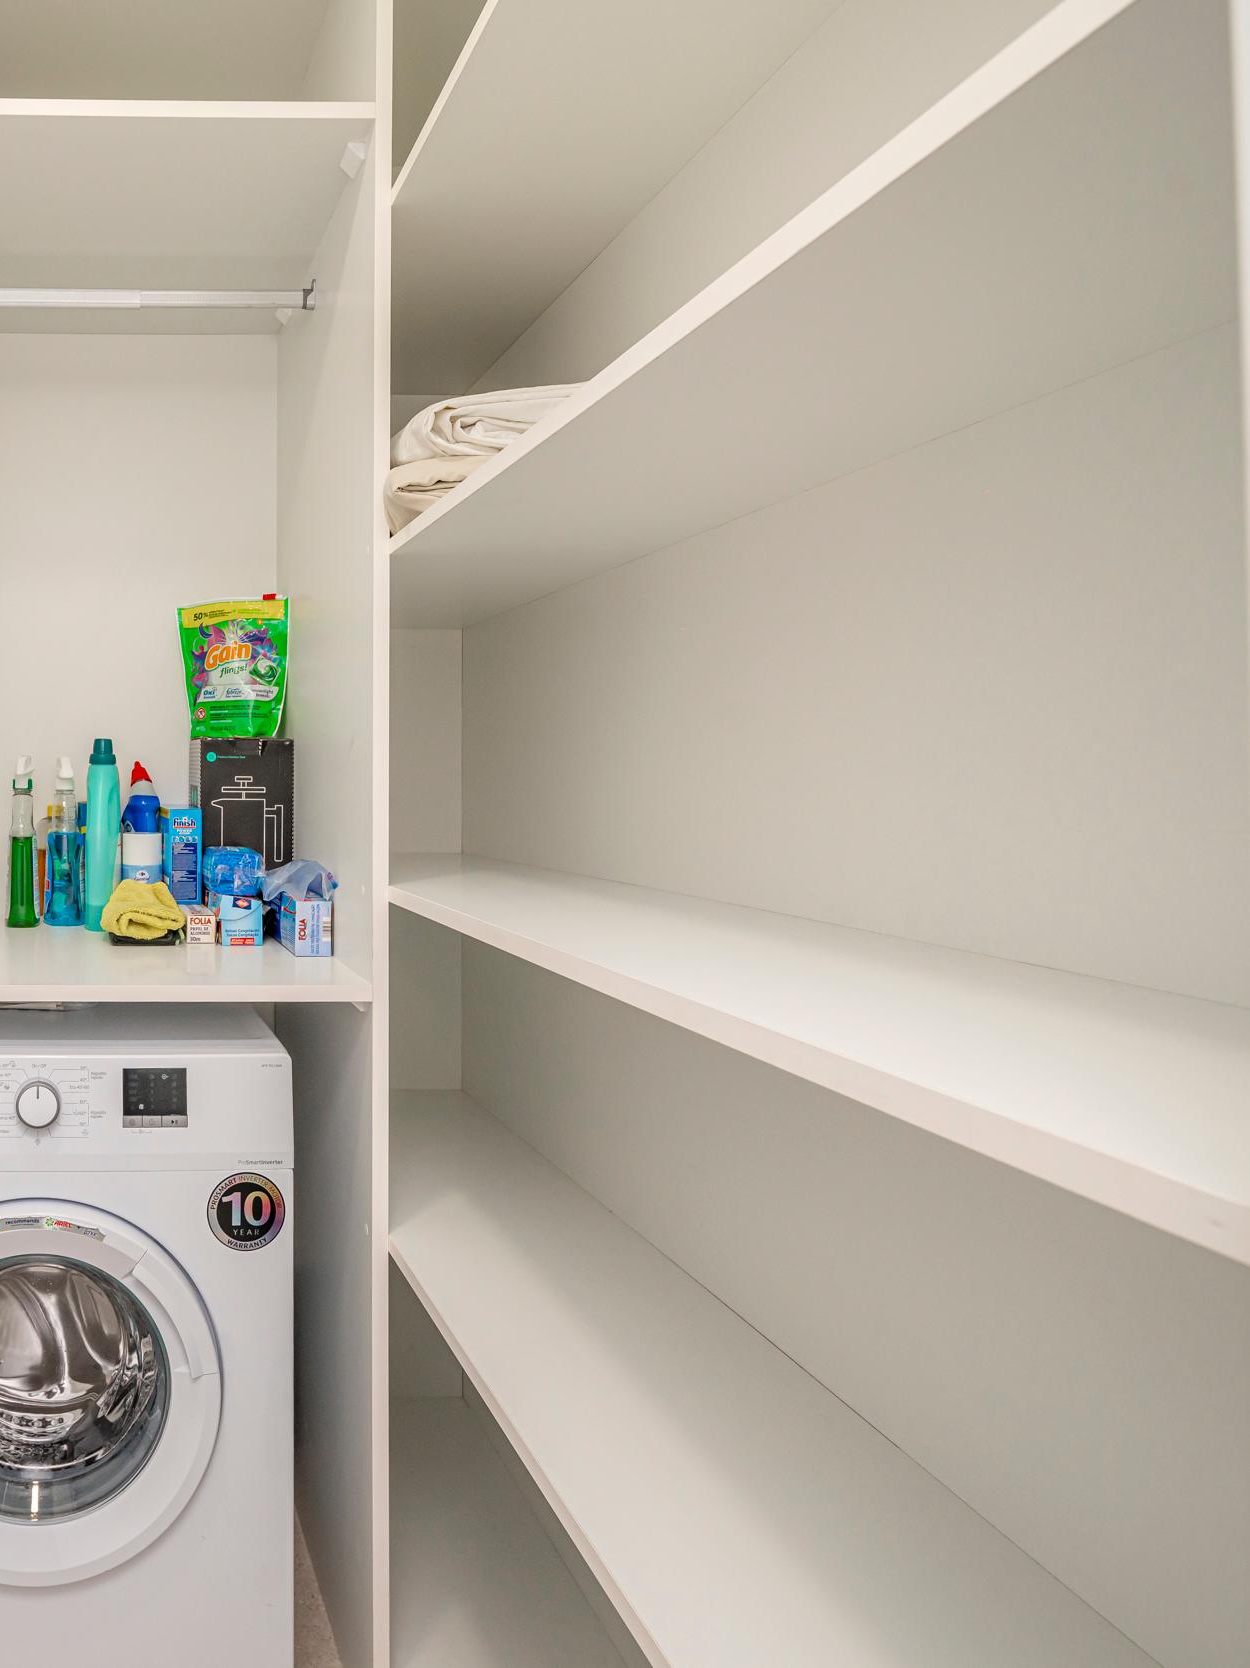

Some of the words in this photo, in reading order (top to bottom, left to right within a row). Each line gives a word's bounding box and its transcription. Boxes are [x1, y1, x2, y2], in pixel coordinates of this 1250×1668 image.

[205, 640, 252, 671] Gain
[173, 817, 196, 827] finish
[190, 917, 212, 925] FOLIA
[298, 919, 307, 941] FOLIA
[210, 1177, 237, 1210] PROSMART
[238, 1175, 269, 1188] INVERTER
[221, 1190, 271, 1227] 10
[53, 1220, 72, 1228] ARIEL
[227, 1237, 267, 1249] WARRANTY
